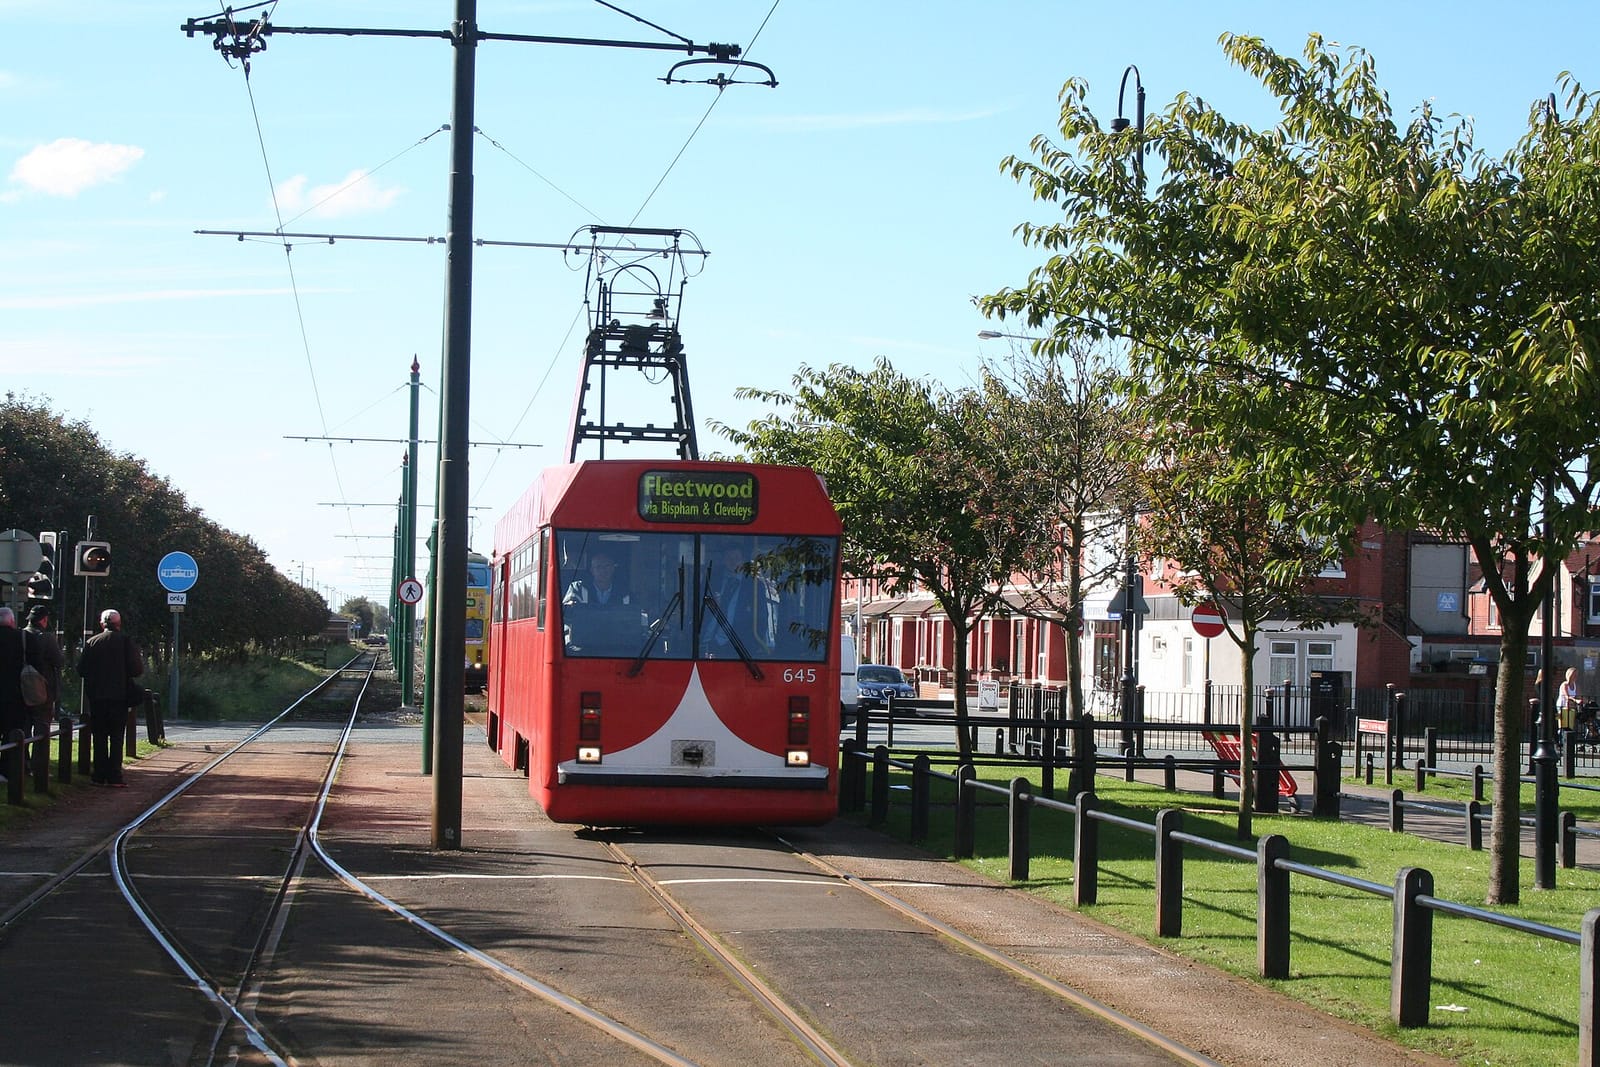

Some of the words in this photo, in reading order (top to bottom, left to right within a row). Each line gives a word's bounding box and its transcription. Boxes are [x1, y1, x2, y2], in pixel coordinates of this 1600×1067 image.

[644, 476, 753, 498] Fleetwood
[644, 501, 658, 514] via
[661, 501, 699, 518] Bispham
[702, 502, 710, 515] &
[714, 502, 752, 520] Cleveleys
[783, 668, 816, 682] 645
